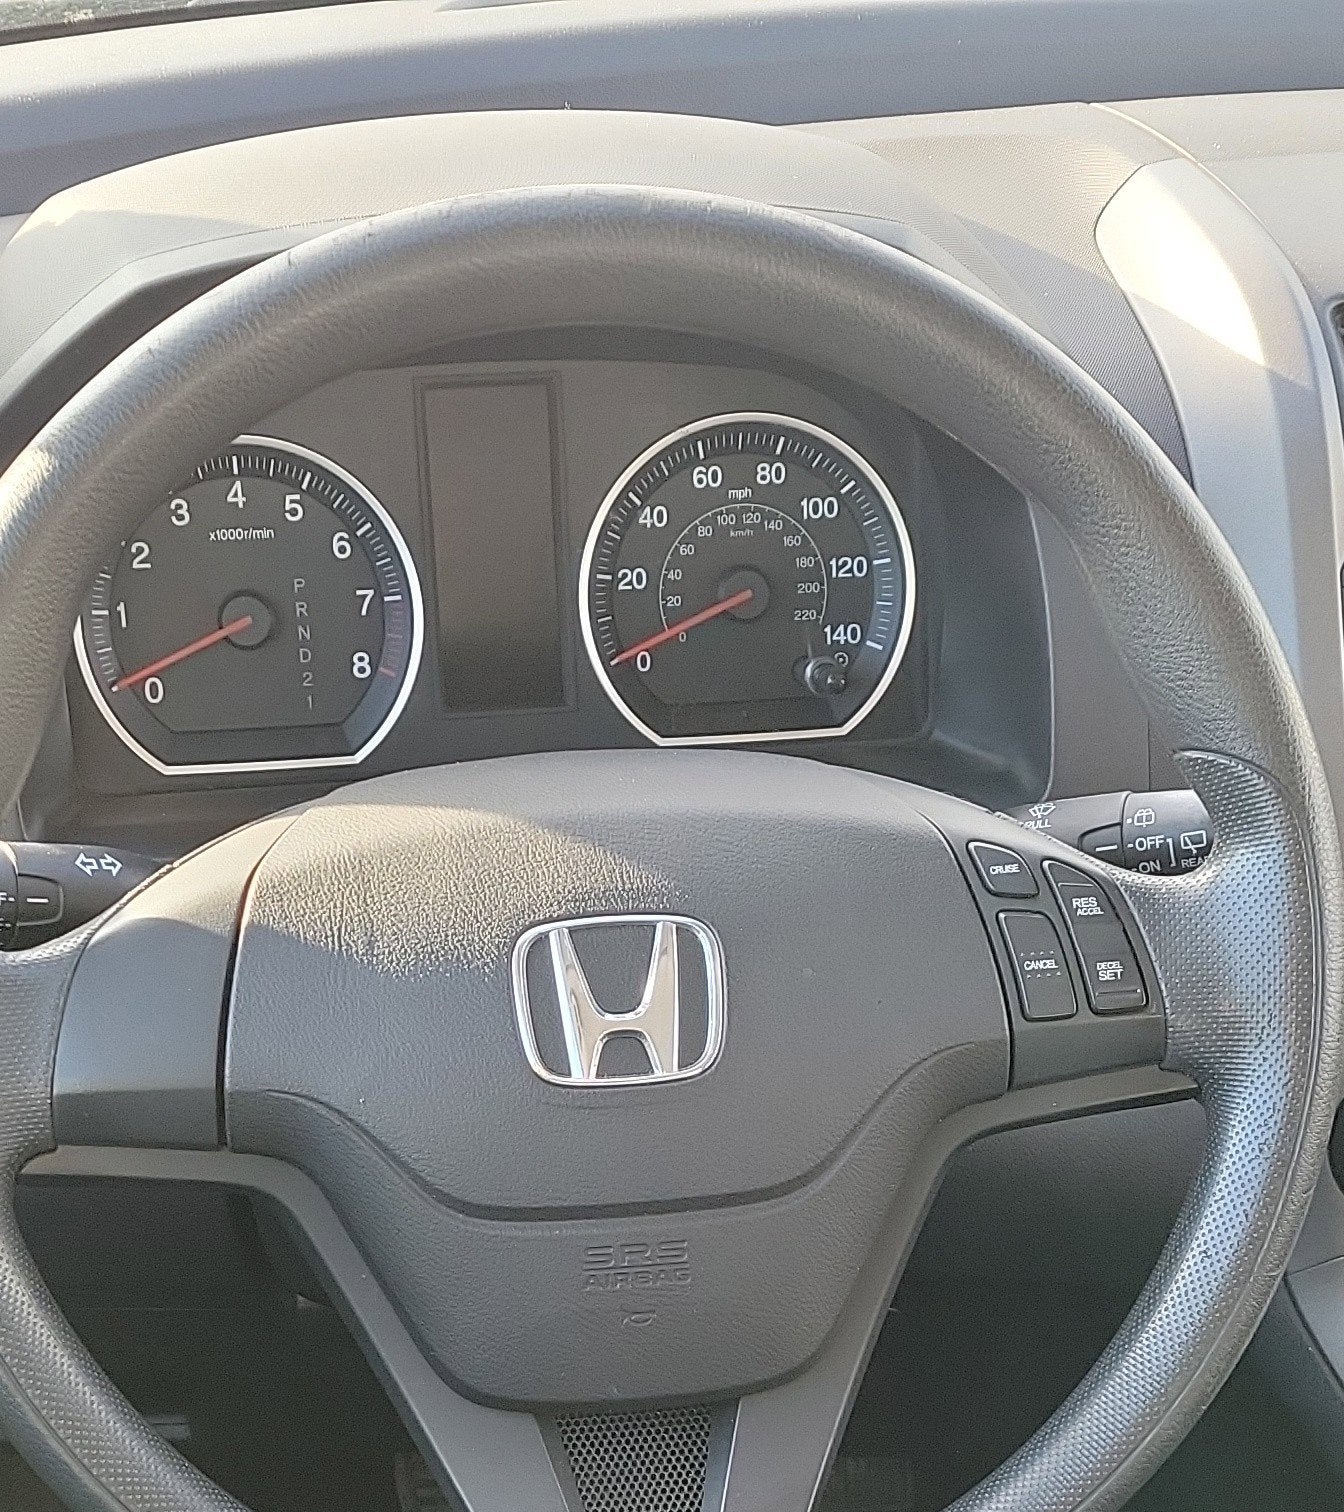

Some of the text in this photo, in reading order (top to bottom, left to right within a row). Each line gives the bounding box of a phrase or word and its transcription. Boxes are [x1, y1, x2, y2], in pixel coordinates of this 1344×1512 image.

[693, 465, 722, 488] 60
[756, 462, 786, 485] 80
[227, 480, 247, 508] 4
[729, 487, 752, 501] mph
[170, 498, 190, 526] 3
[284, 494, 304, 521] 5
[801, 496, 839, 520] 100
[639, 505, 668, 528] 40
[717, 513, 736, 525] 100
[742, 512, 761, 524] 120
[698, 525, 713, 537] 80
[764, 519, 783, 531] 140
[208, 526, 275, 542] x1000r/min
[729, 528, 754, 538] km/h
[783, 534, 802, 547] 160
[332, 532, 352, 559] 6
[680, 543, 695, 556] 60
[131, 541, 151, 569] 2
[795, 556, 815, 568] 180
[667, 568, 682, 581] 40
[830, 556, 868, 579] 120
[294, 578, 306, 593] P
[618, 567, 647, 590] 20
[797, 582, 820, 594] 200
[356, 589, 375, 616] 7
[666, 595, 682, 607] 20
[117, 601, 128, 628] 1
[296, 601, 308, 617] R
[794, 609, 817, 621] 220
[298, 625, 311, 640] N
[679, 631, 687, 643] 0
[824, 623, 861, 645] 140
[300, 647, 312, 663] D
[636, 650, 651, 672] 0
[352, 651, 372, 678] 8
[303, 672, 315, 687] 2
[144, 677, 164, 704] 0
[308, 694, 315, 709] 1
[1135, 835, 1164, 851] OFF
[989, 863, 1021, 875] CRUISE
[1139, 860, 1162, 874] ON
[1072, 897, 1098, 908] RES
[1076, 906, 1104, 917] ACCEL
[1024, 959, 1059, 971] CANCEL
[1097, 961, 1124, 971] DECEL
[1098, 969, 1123, 981] SET
[584, 1239, 689, 1267] SRS
[583, 1267, 692, 1292] AIRBAG
